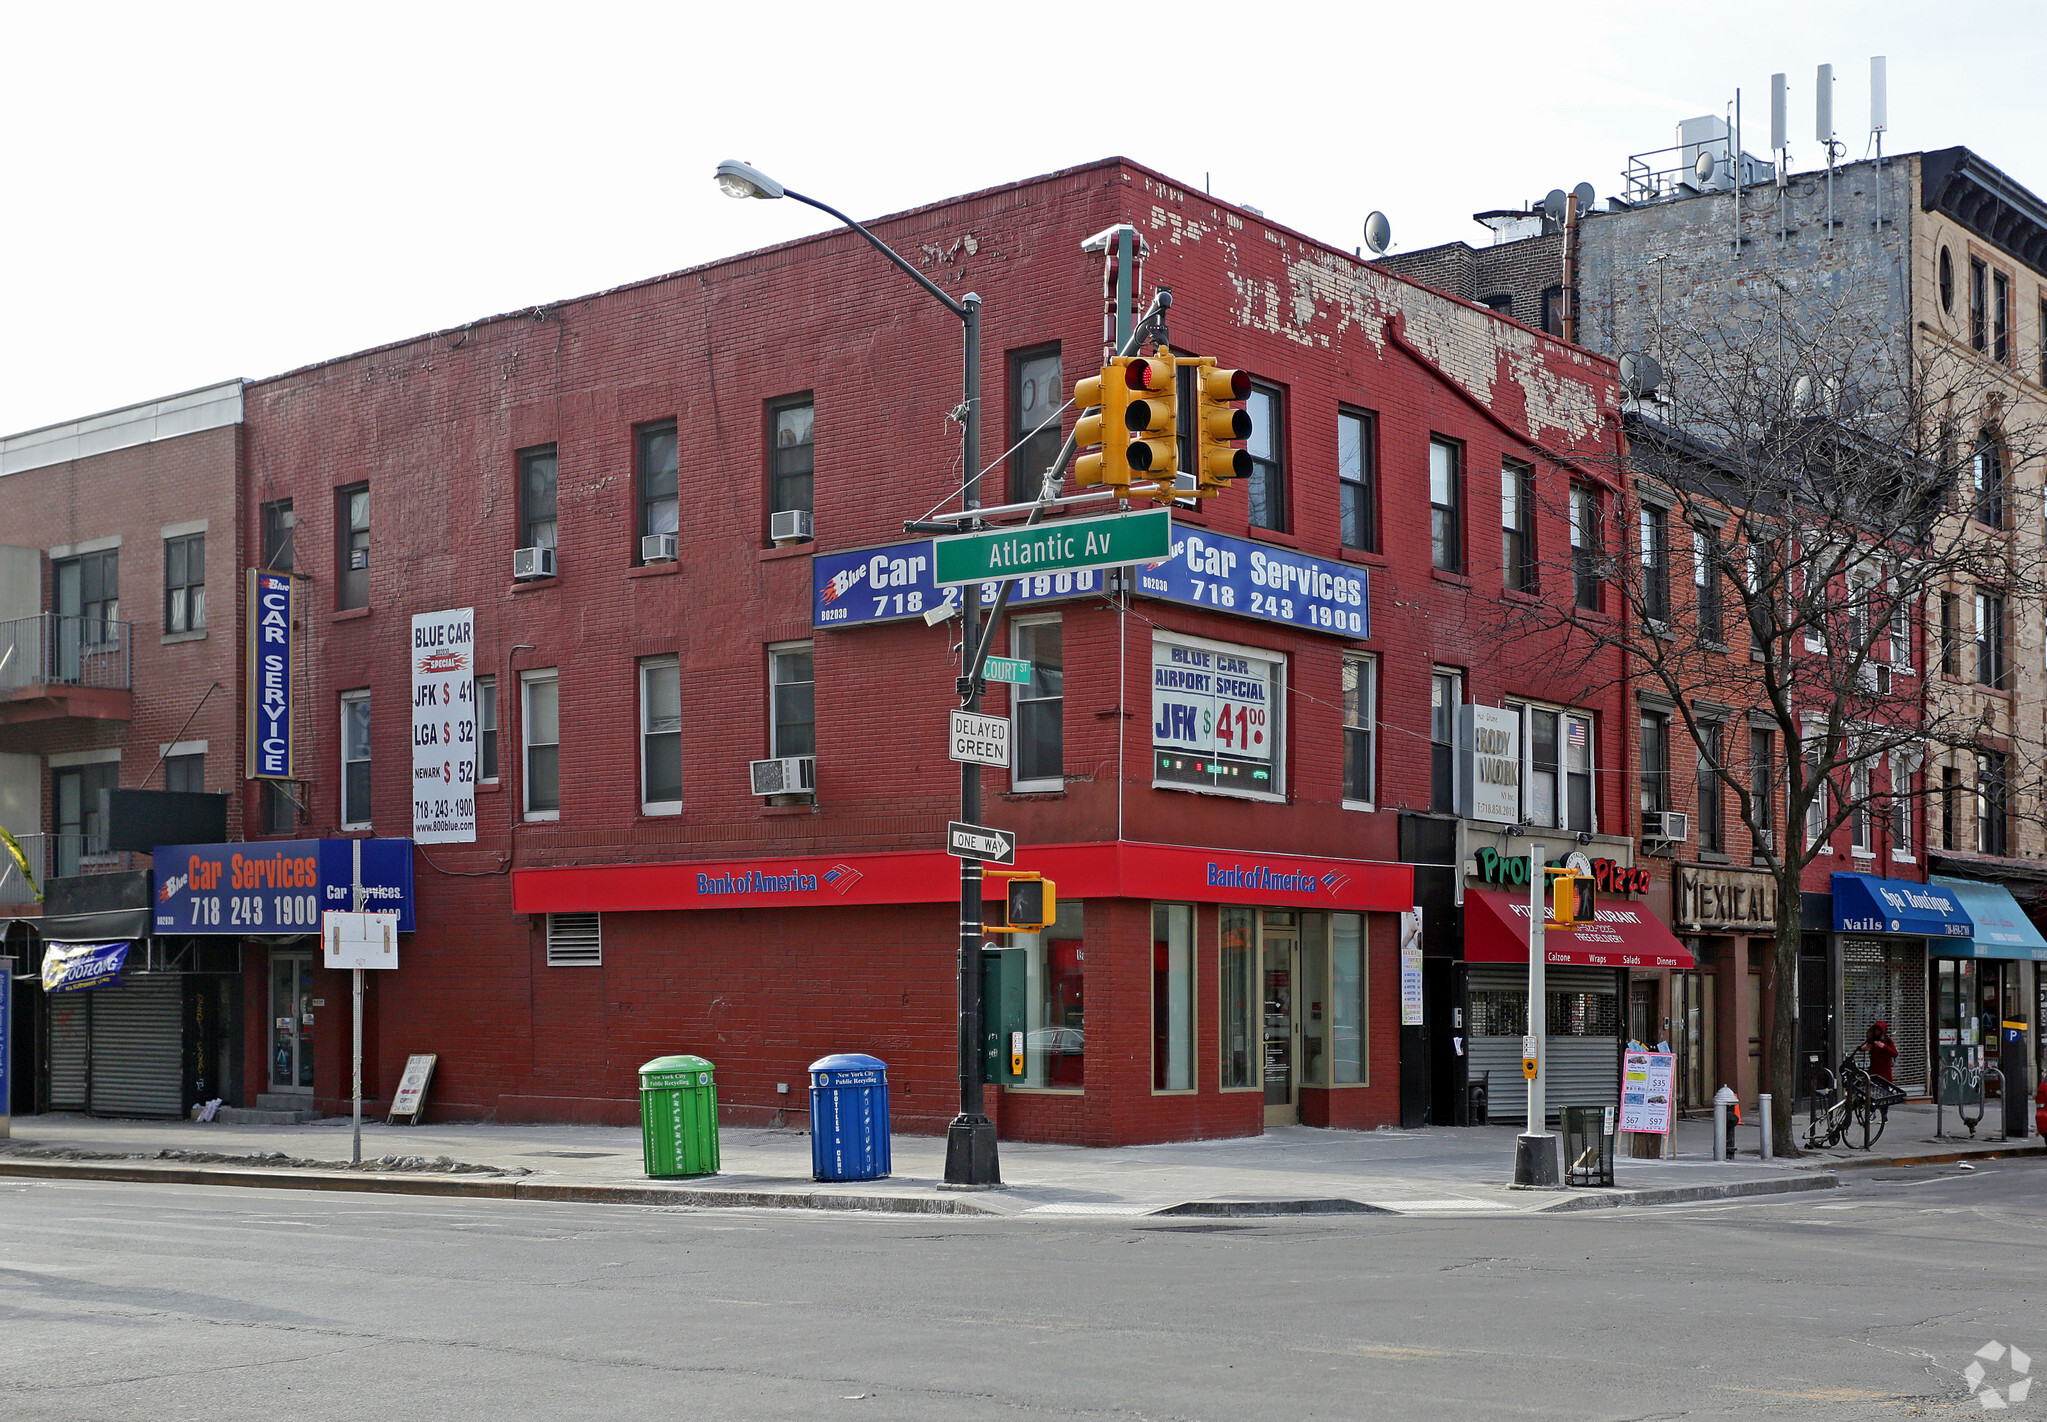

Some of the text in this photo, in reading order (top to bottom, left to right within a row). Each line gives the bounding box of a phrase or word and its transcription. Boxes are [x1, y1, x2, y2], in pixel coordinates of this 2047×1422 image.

[989, 531, 1111, 568] Atlantic Av
[833, 555, 926, 596] Blue Car
[1171, 536, 1361, 606] ue Car Services
[873, 570, 1093, 616] 718 23 1900
[1190, 579, 1361, 632] 718 243 1900
[262, 594, 287, 644] CAR
[416, 622, 471, 648] BLUE CAR
[431, 658, 455, 669] SPECIAL
[984, 660, 1028, 680] COURT ST
[1172, 648, 1249, 674] BLUE CAR
[415, 680, 472, 707] JFK $ 41
[1155, 669, 1265, 700] AIRPORT SPECIAL
[262, 655, 286, 771] SERVICE
[1156, 703, 1197, 742] JFK
[415, 720, 473, 746] LGA $ 32
[956, 719, 1005, 740] DELAYED
[1478, 727, 1511, 755] BODY
[957, 739, 1003, 759] GREEN
[415, 760, 473, 785] NEWARK $ 52
[1483, 757, 1518, 786] WORK
[416, 821, 474, 833] www.800blue.com
[958, 834, 1004, 853] ONE WAY
[167, 852, 317, 898] Blue Car Services
[327, 884, 400, 899] Car ervices
[1880, 887, 1954, 917] Spa Boutique
[191, 897, 220, 925] 718
[231, 896, 263, 925] 243
[274, 895, 317, 925] 1900
[1594, 910, 1642, 924] AURANT
[1843, 918, 1882, 930] Nails
[1548, 952, 1676, 966] Calzone Wraps Salads Dinners
[2010, 1030, 2017, 1041] P
[1626, 1117, 1662, 1126] $67 $97
